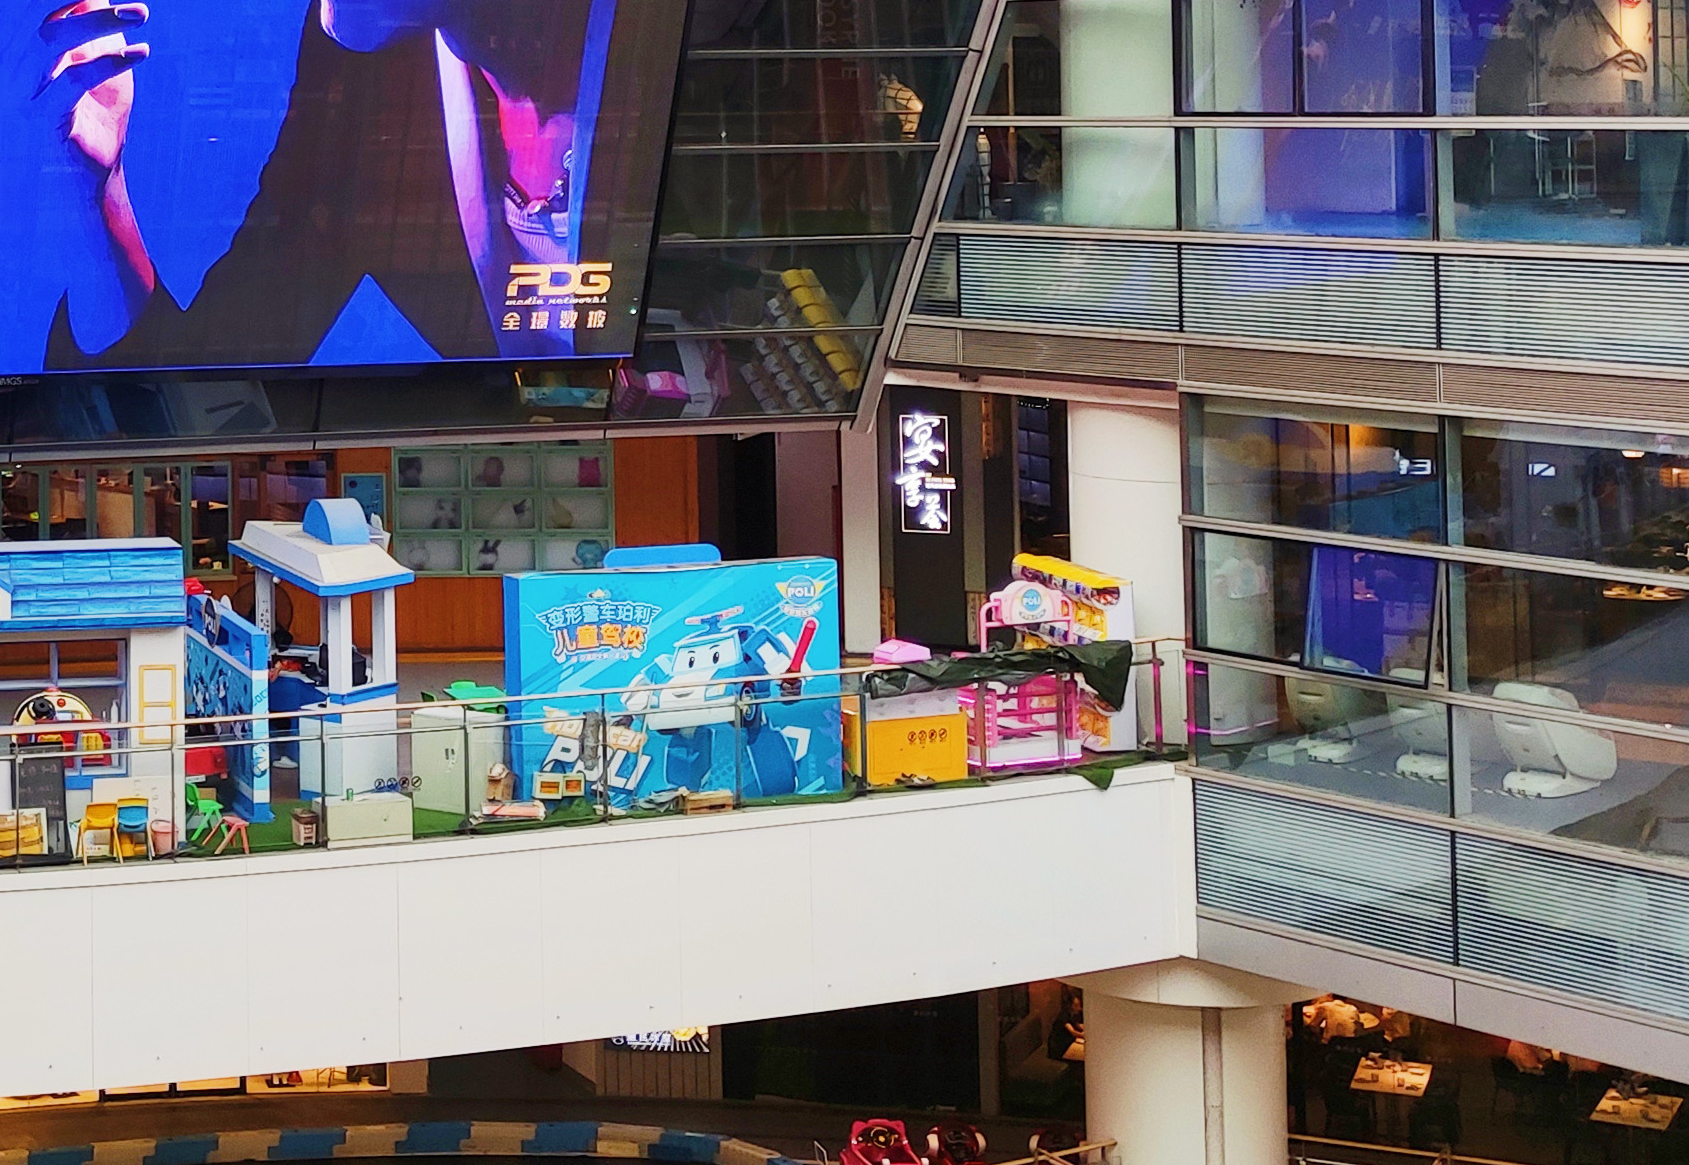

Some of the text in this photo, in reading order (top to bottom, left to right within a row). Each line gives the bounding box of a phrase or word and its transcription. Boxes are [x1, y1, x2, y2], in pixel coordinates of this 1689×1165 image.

[507, 263, 612, 296] PDG
[505, 296, 544, 305] media
[787, 586, 815, 597] POLI
[547, 604, 651, 629] 变形警车珀利
[554, 623, 644, 656] 儿童驾校
